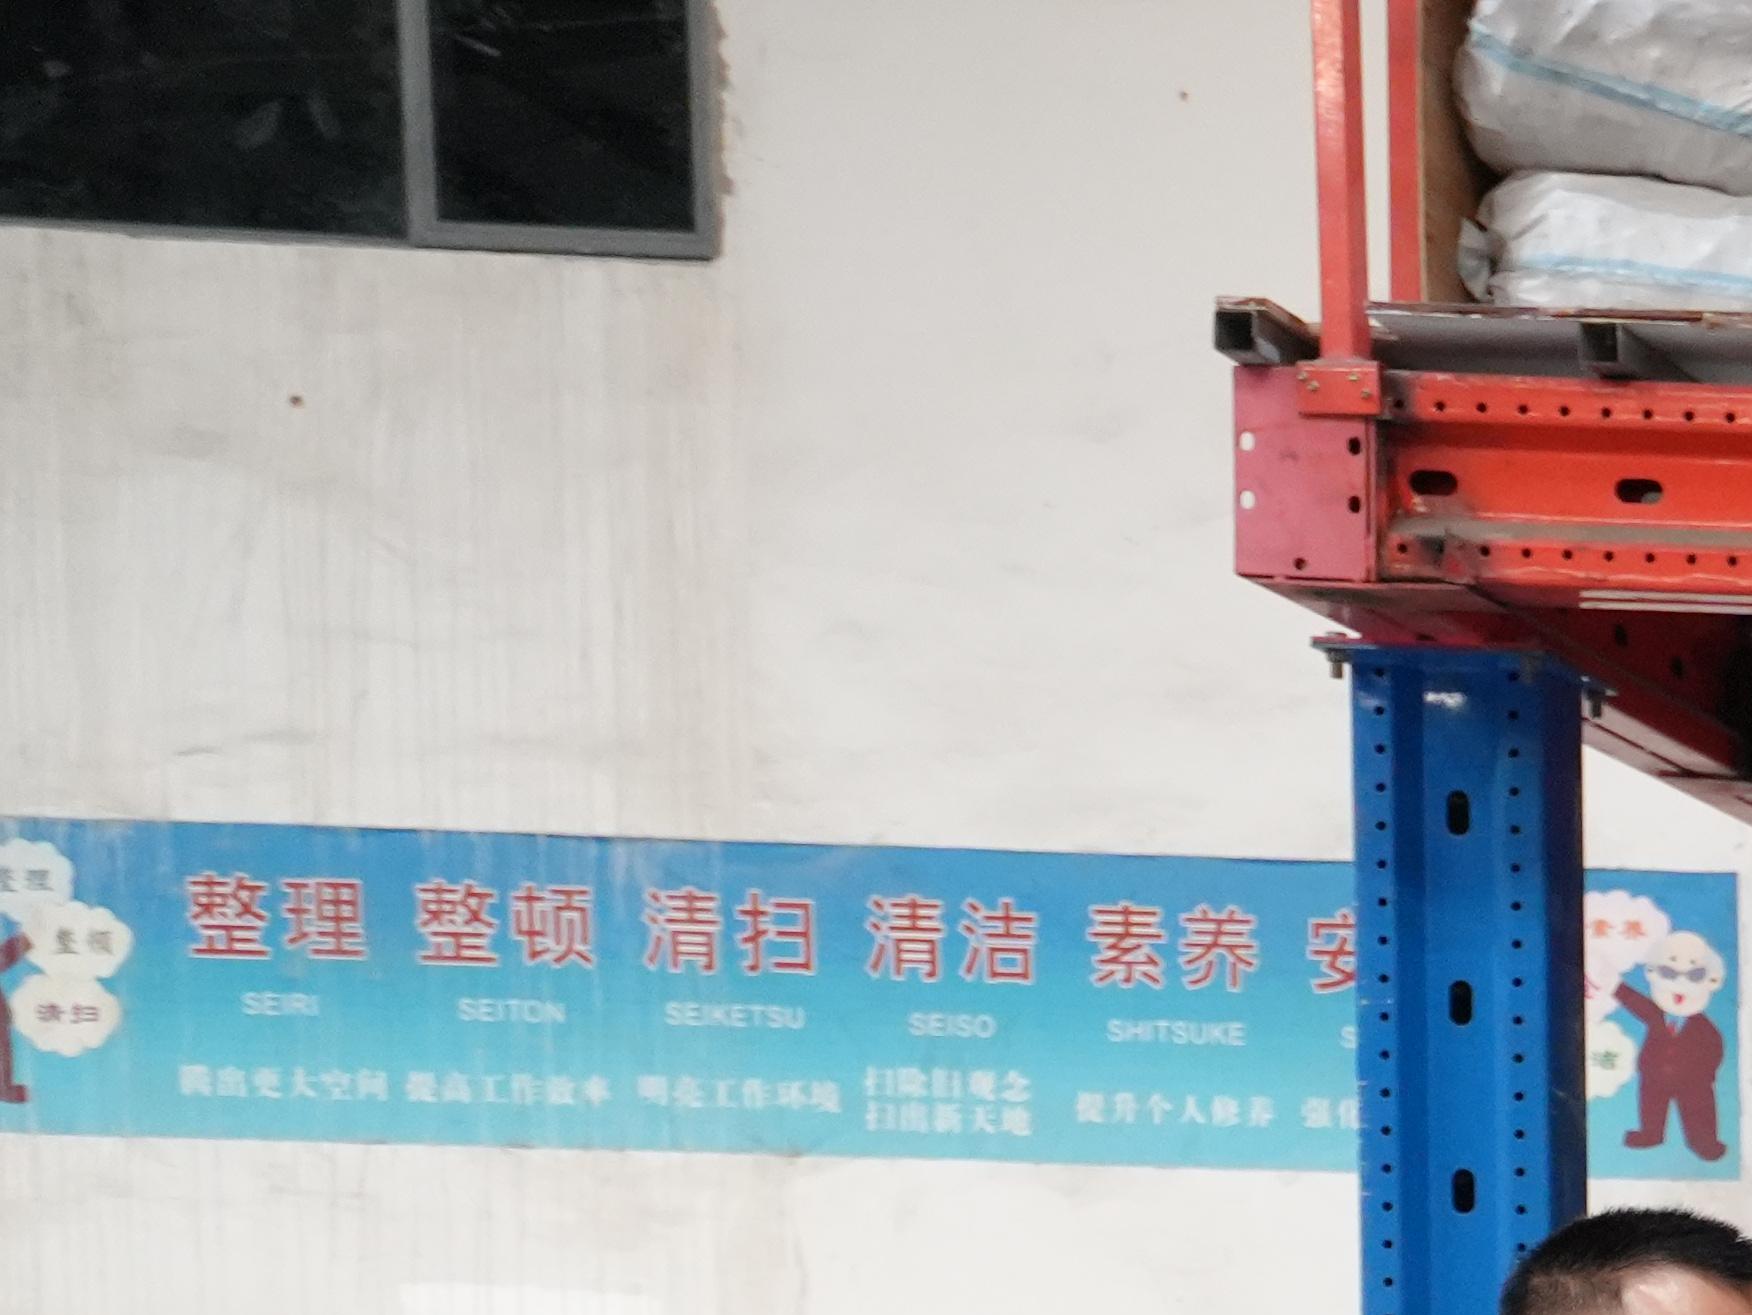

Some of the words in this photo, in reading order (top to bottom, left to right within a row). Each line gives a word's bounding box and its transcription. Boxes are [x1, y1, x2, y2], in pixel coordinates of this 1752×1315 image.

[187, 871, 368, 961] 整理
[413, 878, 596, 970] 整顿
[644, 885, 818, 977] 清扫
[866, 894, 1038, 983] 清洁
[1087, 901, 1258, 991] 素养
[241, 991, 320, 1016] SEIRI
[456, 998, 567, 1023] SEITON
[664, 1001, 806, 1030] SEIKETSU
[907, 1012, 997, 1038] SEISO
[1107, 1019, 1247, 1046] SHITSUKE
